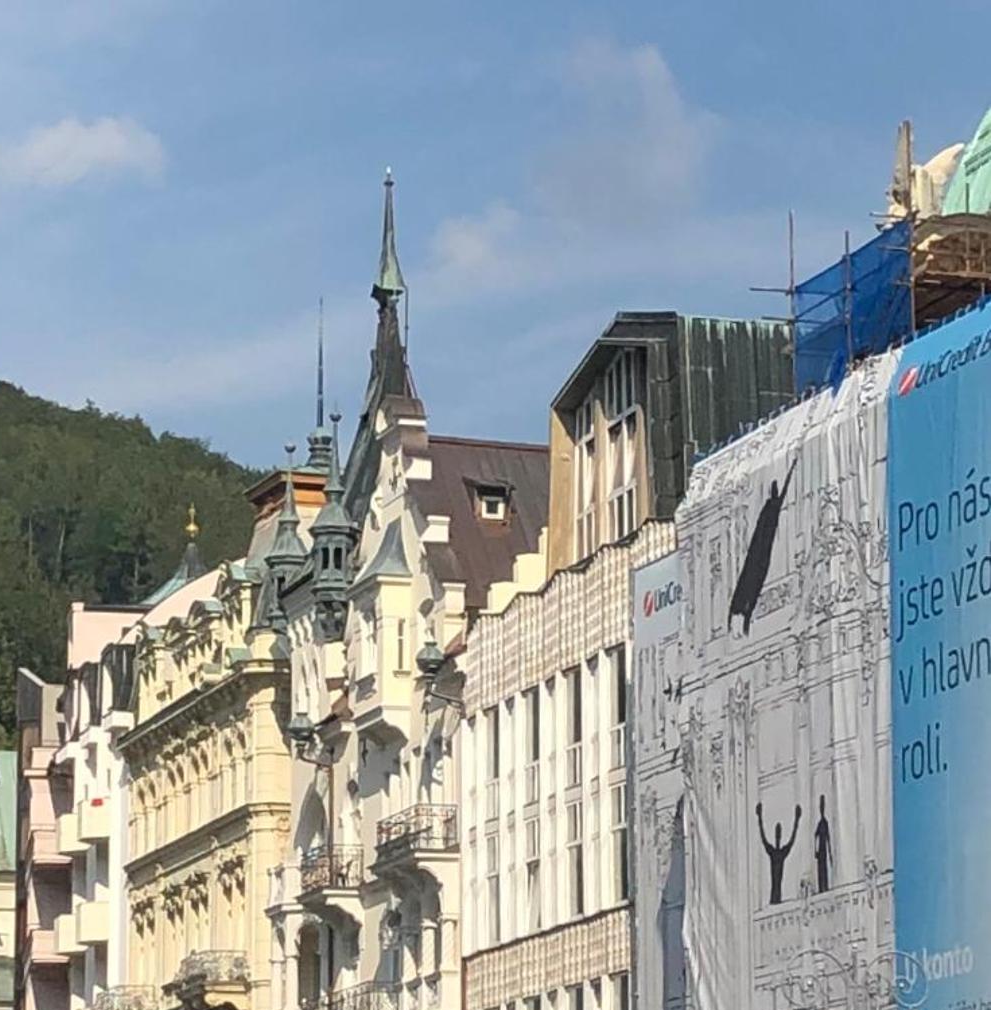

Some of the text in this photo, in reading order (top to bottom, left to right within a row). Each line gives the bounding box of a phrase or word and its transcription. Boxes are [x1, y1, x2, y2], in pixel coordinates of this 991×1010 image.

[898, 467, 991, 552] Pro nás
[895, 574, 944, 643] jste
[899, 665, 913, 705] v
[901, 721, 948, 783] roli.
[922, 946, 974, 981] konto
